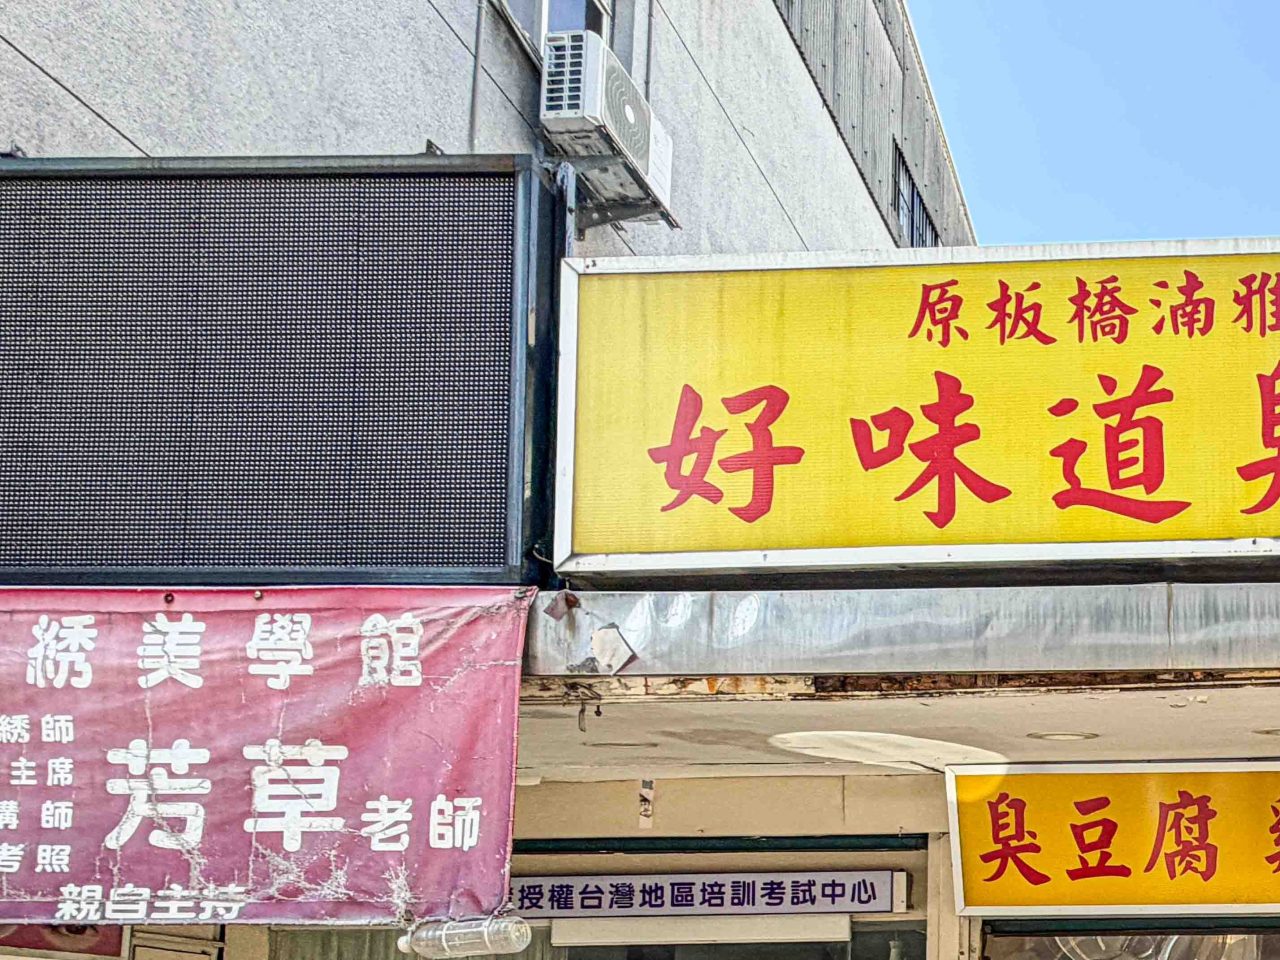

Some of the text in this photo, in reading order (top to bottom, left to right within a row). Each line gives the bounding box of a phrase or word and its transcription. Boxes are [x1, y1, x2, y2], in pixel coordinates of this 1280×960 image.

[26, 612, 425, 691] 綉美學館
[10, 757, 75, 787] 主席
[979, 790, 1219, 886] 臭豆腐
[508, 877, 877, 911] 授權台灣地區培訓考試中心
